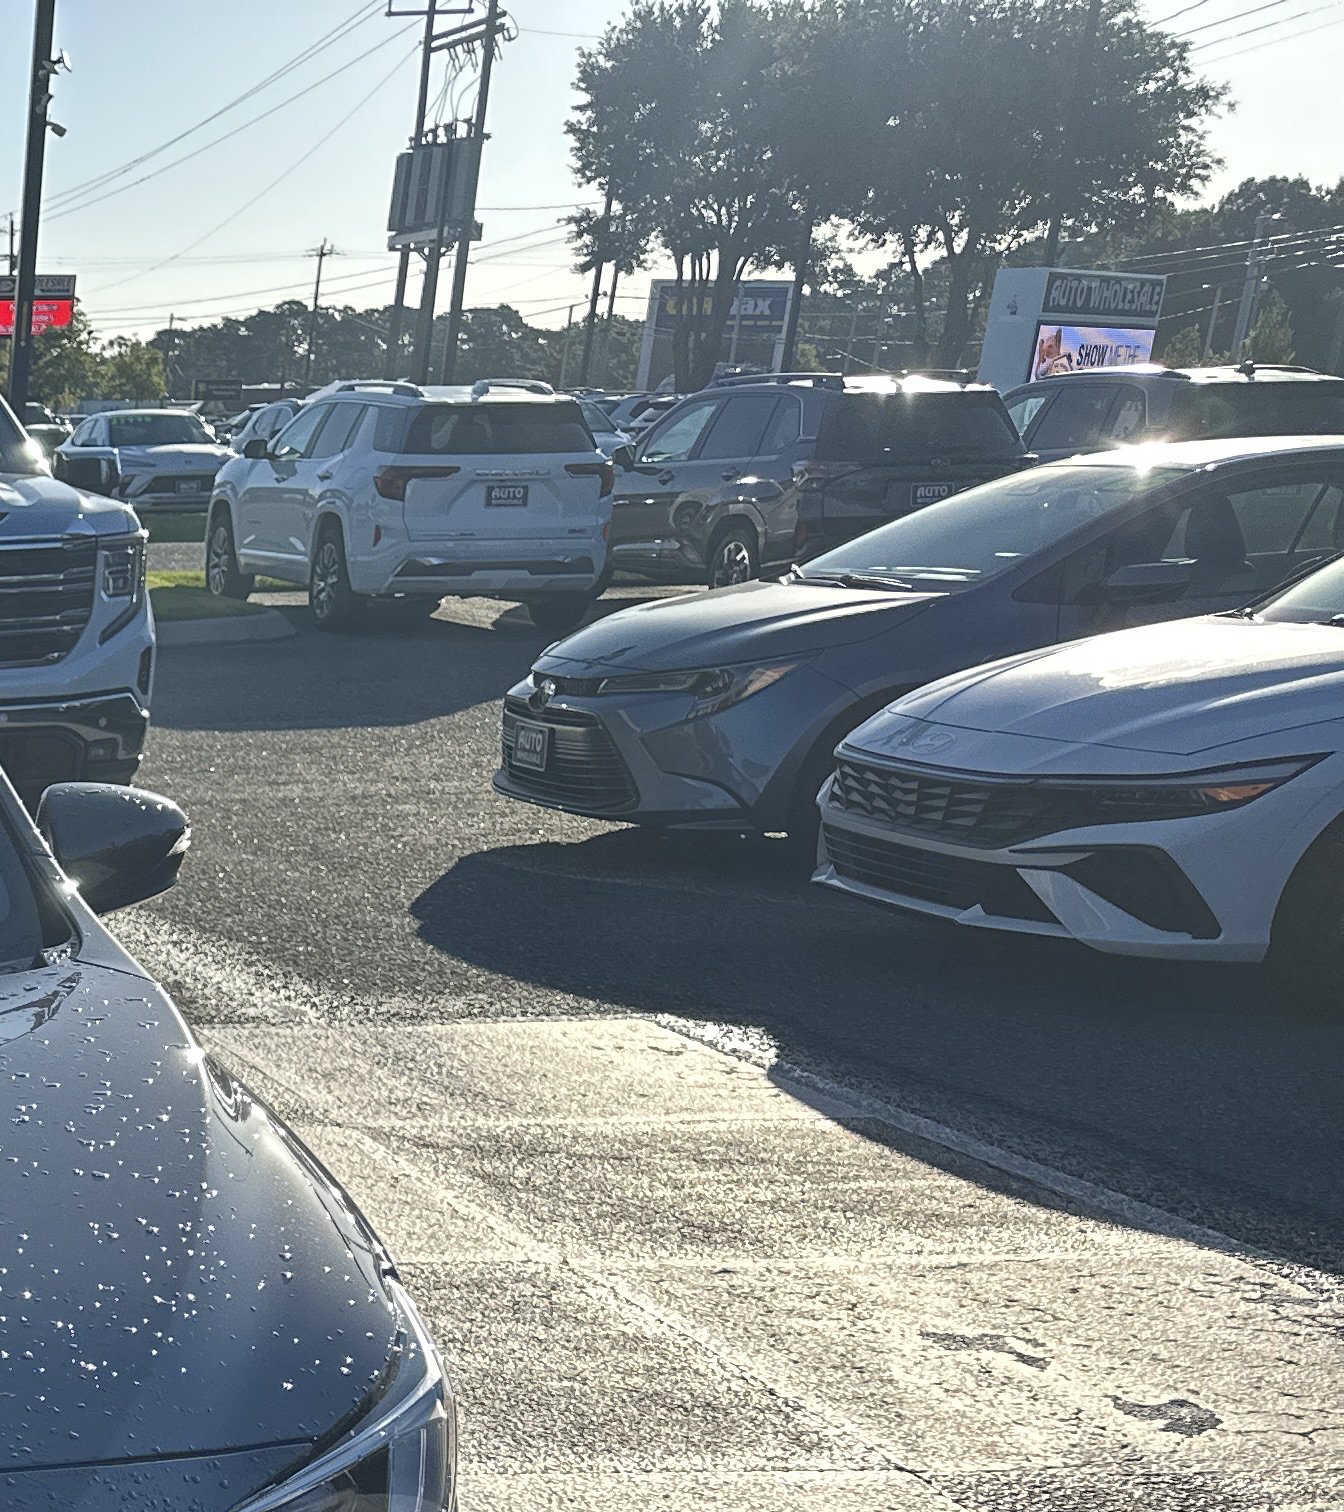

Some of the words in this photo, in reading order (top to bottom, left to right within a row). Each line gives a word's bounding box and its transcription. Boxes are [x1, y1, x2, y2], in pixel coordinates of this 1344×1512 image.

[1049, 278, 1089, 308] AUTO
[1089, 278, 1161, 313] WHOLESALE
[1076, 344, 1109, 367] SHOW
[491, 487, 524, 499] AUTO
[916, 486, 949, 498] AUTO
[518, 729, 543, 752] AUTO
